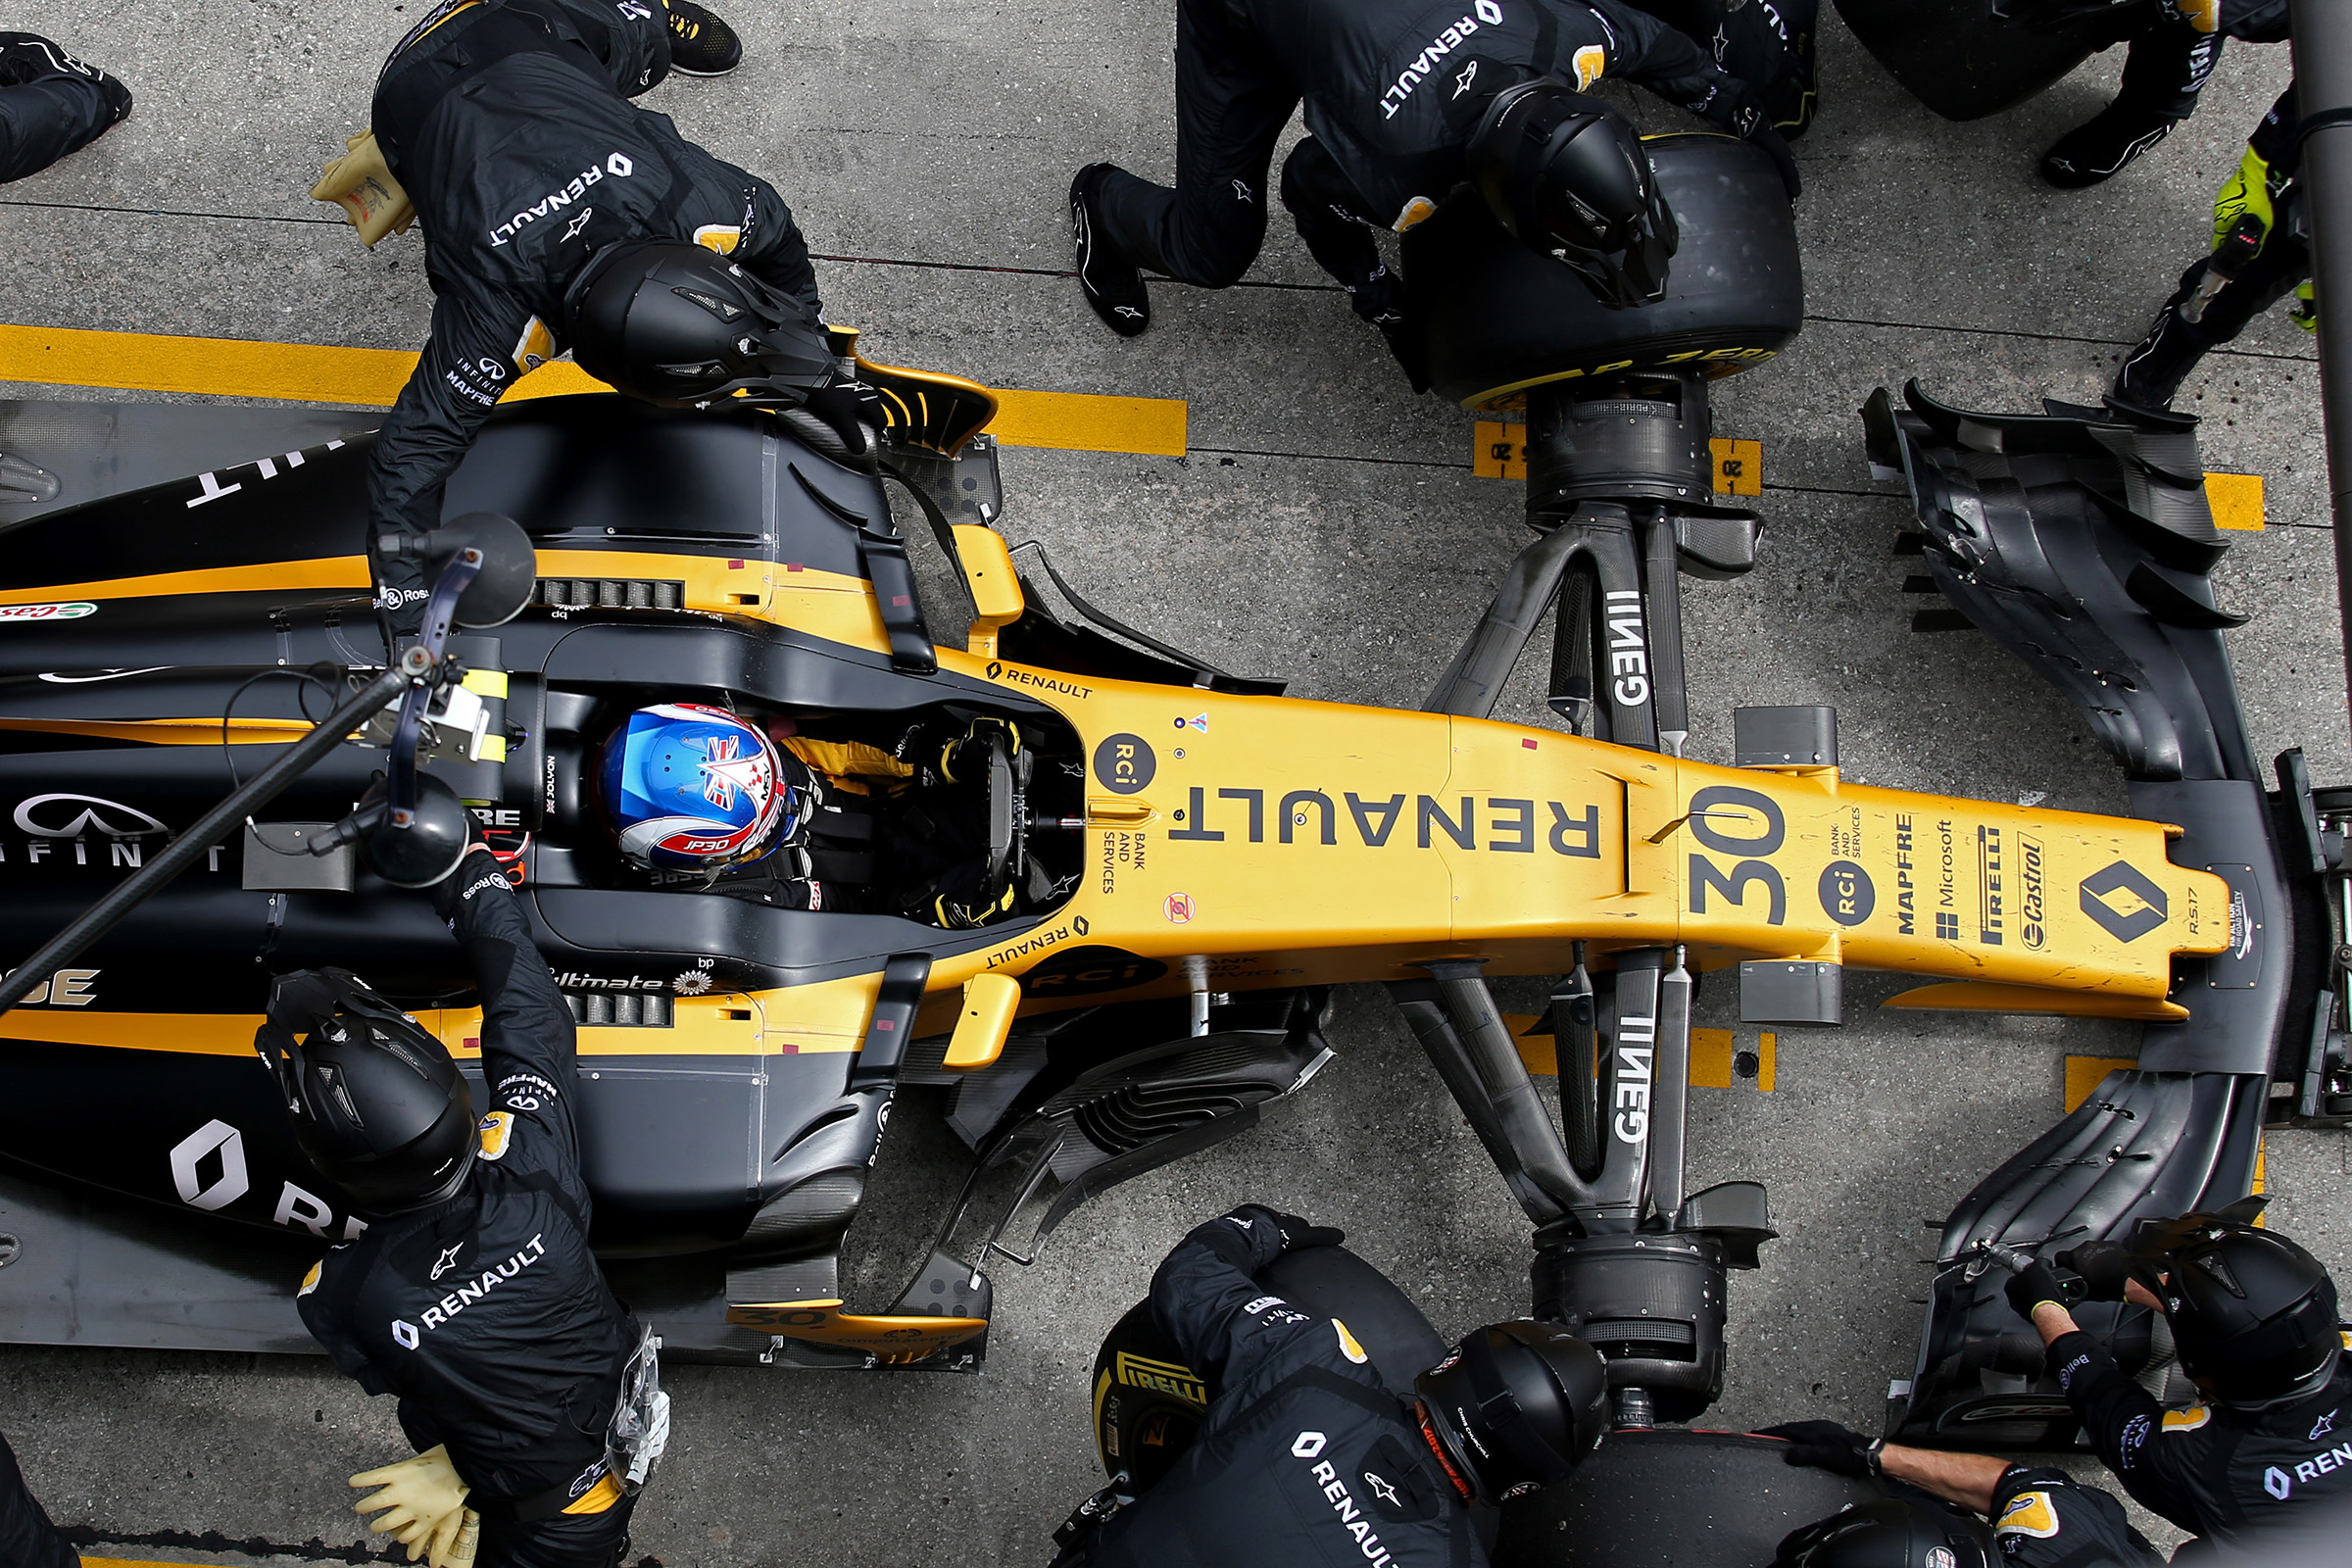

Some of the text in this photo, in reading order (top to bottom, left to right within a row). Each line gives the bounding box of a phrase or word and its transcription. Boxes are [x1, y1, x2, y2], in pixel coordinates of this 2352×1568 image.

[1380, 16, 1479, 120] RENAULT
[489, 165, 604, 247] RENAULT
[446, 370, 495, 407] MAPFRE
[1006, 668, 1093, 700] RENAULT
[547, 755, 556, 799] JOLYON
[760, 762, 771, 801] MSV
[1114, 743, 1138, 785] RCi
[684, 839, 729, 852] JP30
[1119, 832, 1130, 862] AND
[1168, 786, 1600, 858] RENAULT
[1851, 807, 1860, 858] SERVICES
[1102, 831, 1115, 894] SERVICES
[1134, 833, 1145, 870] BANK
[1689, 785, 1786, 926] 30
[1896, 813, 1914, 935] MAPFRE
[1936, 819, 1954, 907] Microsoft
[1834, 870, 1855, 915] RCi
[1978, 824, 2003, 946] PIRELLI
[2022, 842, 2043, 923] Castrol
[2187, 886, 2198, 935] R.S.17
[698, 957, 714, 969] bp
[986, 926, 1069, 970] RENAULT
[420, 1233, 547, 1331] RENAULT
[1117, 1350, 1207, 1404] PIRELLI
[1457, 1406, 1490, 1459] CHRIS CHURCHILL
[1310, 1459, 1401, 1568] RENAUL
